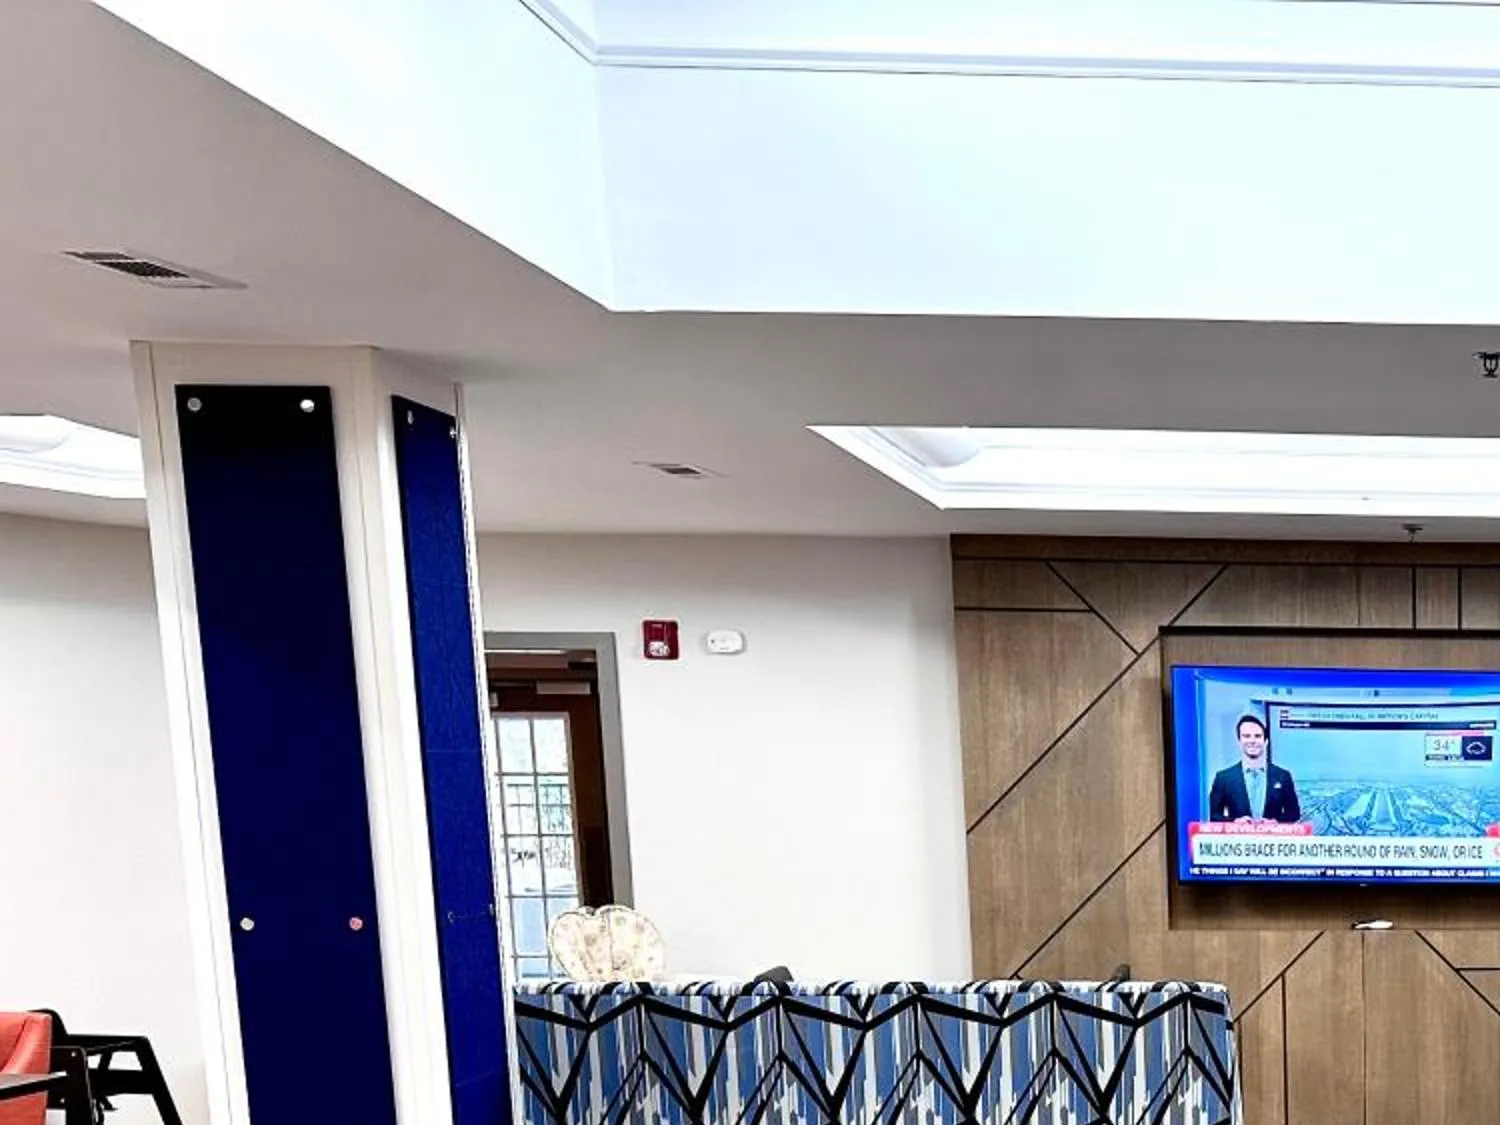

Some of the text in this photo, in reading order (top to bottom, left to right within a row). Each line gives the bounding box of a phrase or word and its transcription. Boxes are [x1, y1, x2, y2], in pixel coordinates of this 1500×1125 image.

[1199, 842, 1483, 861] MILLIONS BRACE FOR ANOTHER ROUND OF RAIN, SNOW, OR ICE
